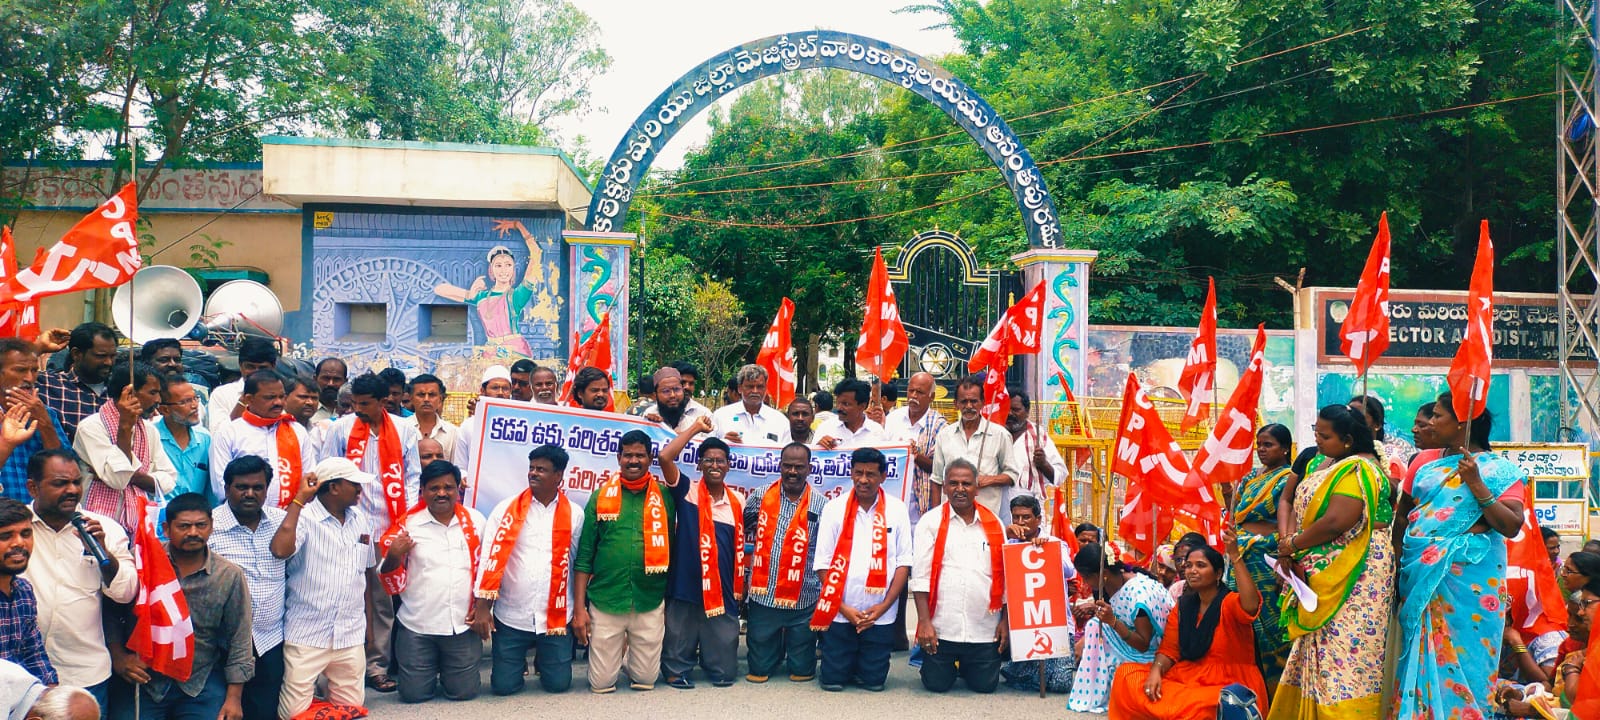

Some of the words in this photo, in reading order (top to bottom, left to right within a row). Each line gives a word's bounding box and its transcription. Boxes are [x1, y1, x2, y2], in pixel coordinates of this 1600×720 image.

[593, 158, 633, 233] కలెక్టరు
[625, 90, 694, 162] మరియు
[693, 63, 735, 96] జిల్లా
[986, 126, 1059, 249] అనంతపురము
[490, 416, 528, 442] కడప
[531, 422, 565, 449] ఉక్కు
[1117, 388, 1153, 466] CPM
[651, 507, 665, 547] CPM
[753, 527, 765, 567] CPM
[486, 530, 507, 572] CPM
[700, 549, 711, 591] CPM
[787, 542, 805, 582] CPM
[869, 528, 883, 571] CPM
[556, 566, 569, 609] CPM
[817, 571, 840, 613] CPM
[1021, 545, 1052, 626] CPM
